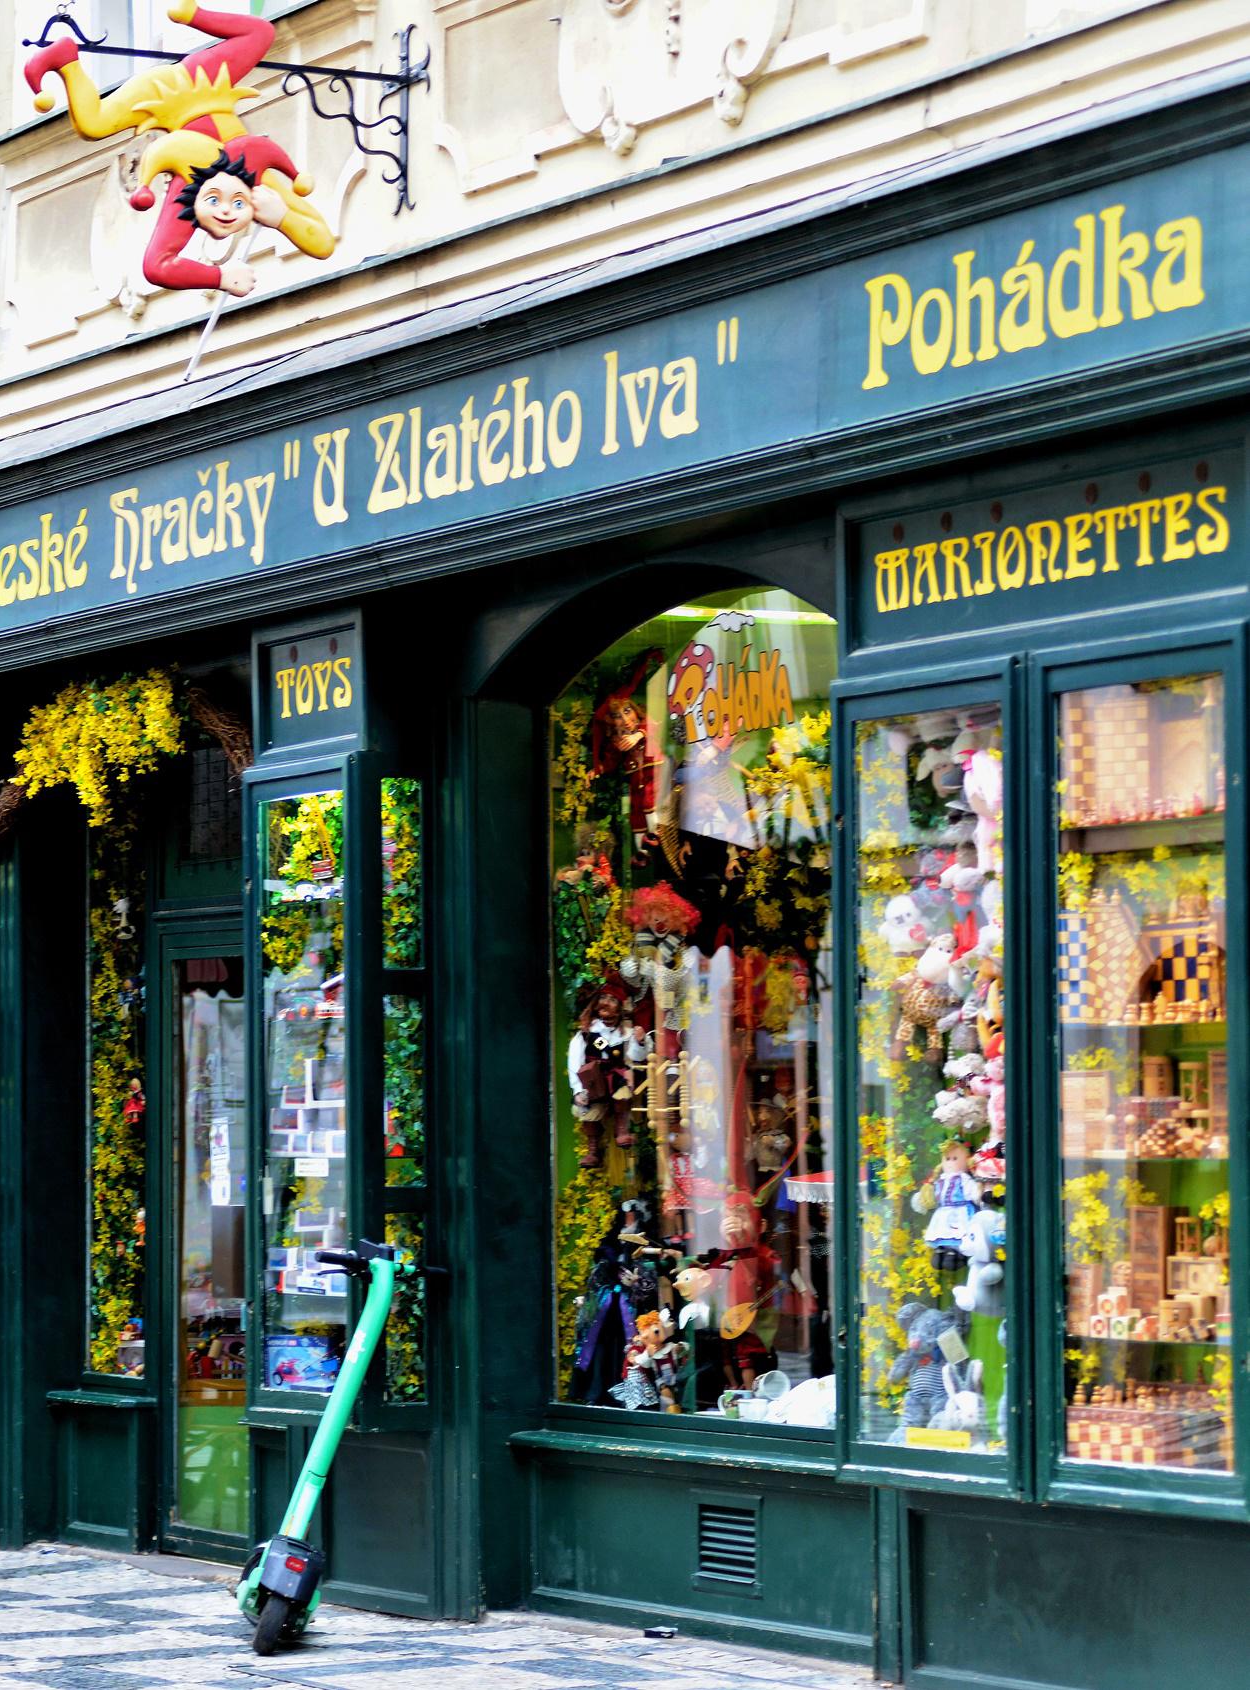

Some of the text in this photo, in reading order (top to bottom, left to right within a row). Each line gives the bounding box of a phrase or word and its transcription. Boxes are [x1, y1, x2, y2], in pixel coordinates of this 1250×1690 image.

[862, 204, 1205, 390] Pohádka
[110, 461, 276, 594] Hračky
[367, 376, 582, 514] Zlatého
[875, 486, 1230, 613] MARIONETTES
[275, 656, 353, 719] TOYS
[671, 643, 794, 744] POHÁDKA
